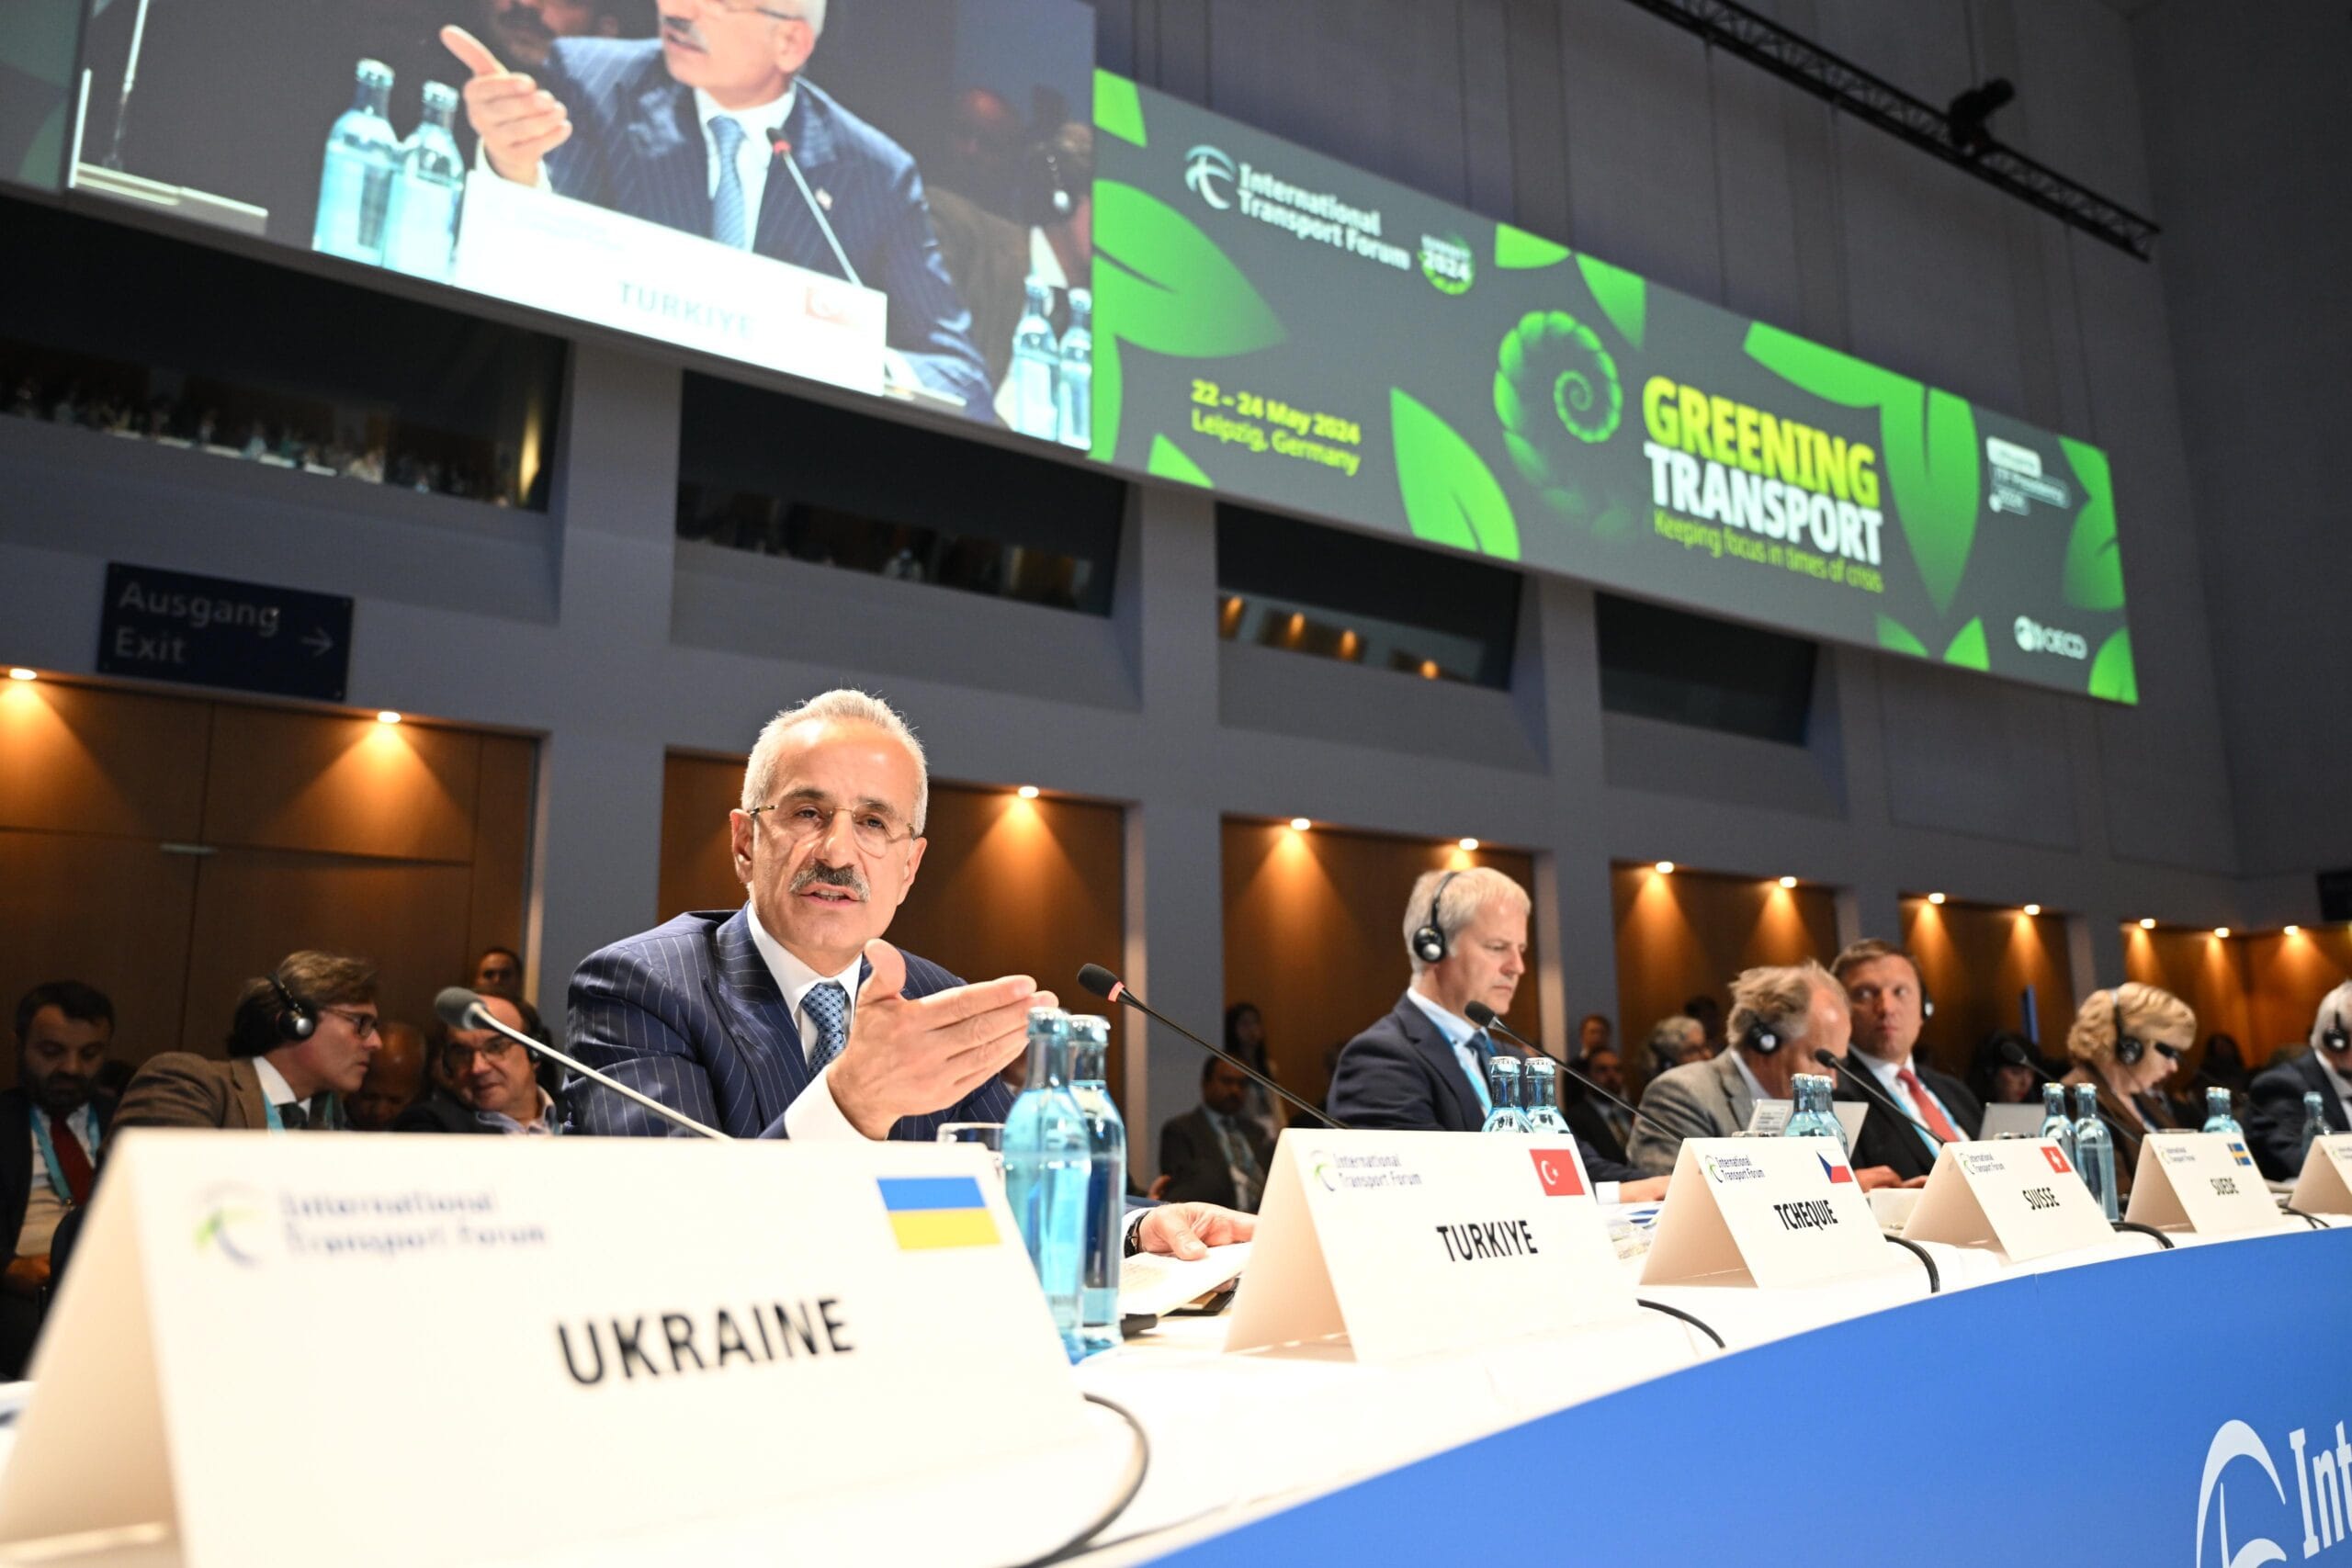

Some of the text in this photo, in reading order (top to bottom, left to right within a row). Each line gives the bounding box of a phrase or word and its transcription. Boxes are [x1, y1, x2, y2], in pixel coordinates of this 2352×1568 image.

[1239, 163, 1382, 237] International
[1237, 187, 1343, 248] Transport
[1345, 226, 1411, 270] Forum
[1191, 378, 1220, 407] 22
[1237, 391, 1264, 419] 24
[1265, 399, 1312, 436] May
[1313, 412, 1362, 446] 2024
[1192, 408, 1362, 477] Leipzig, Germany
[1642, 375, 1881, 511] GREENING
[1644, 440, 1883, 567] TRANSPORT
[1655, 508, 1884, 593] Keeping focus in times of crisis
[119, 581, 280, 637] Ausgang
[114, 626, 185, 663] Exit
[1332, 1153, 1401, 1169] International
[1338, 1170, 1422, 1190] Transport Forum
[1714, 1155, 1752, 1168] International
[1721, 1168, 1766, 1183] Transport Forum
[1773, 1199, 1838, 1231] TCHEQUIE
[2022, 1187, 2060, 1211] SUISSE
[1436, 1220, 1539, 1263] TURKIYE
[556, 1297, 855, 1386] UKRAINE
